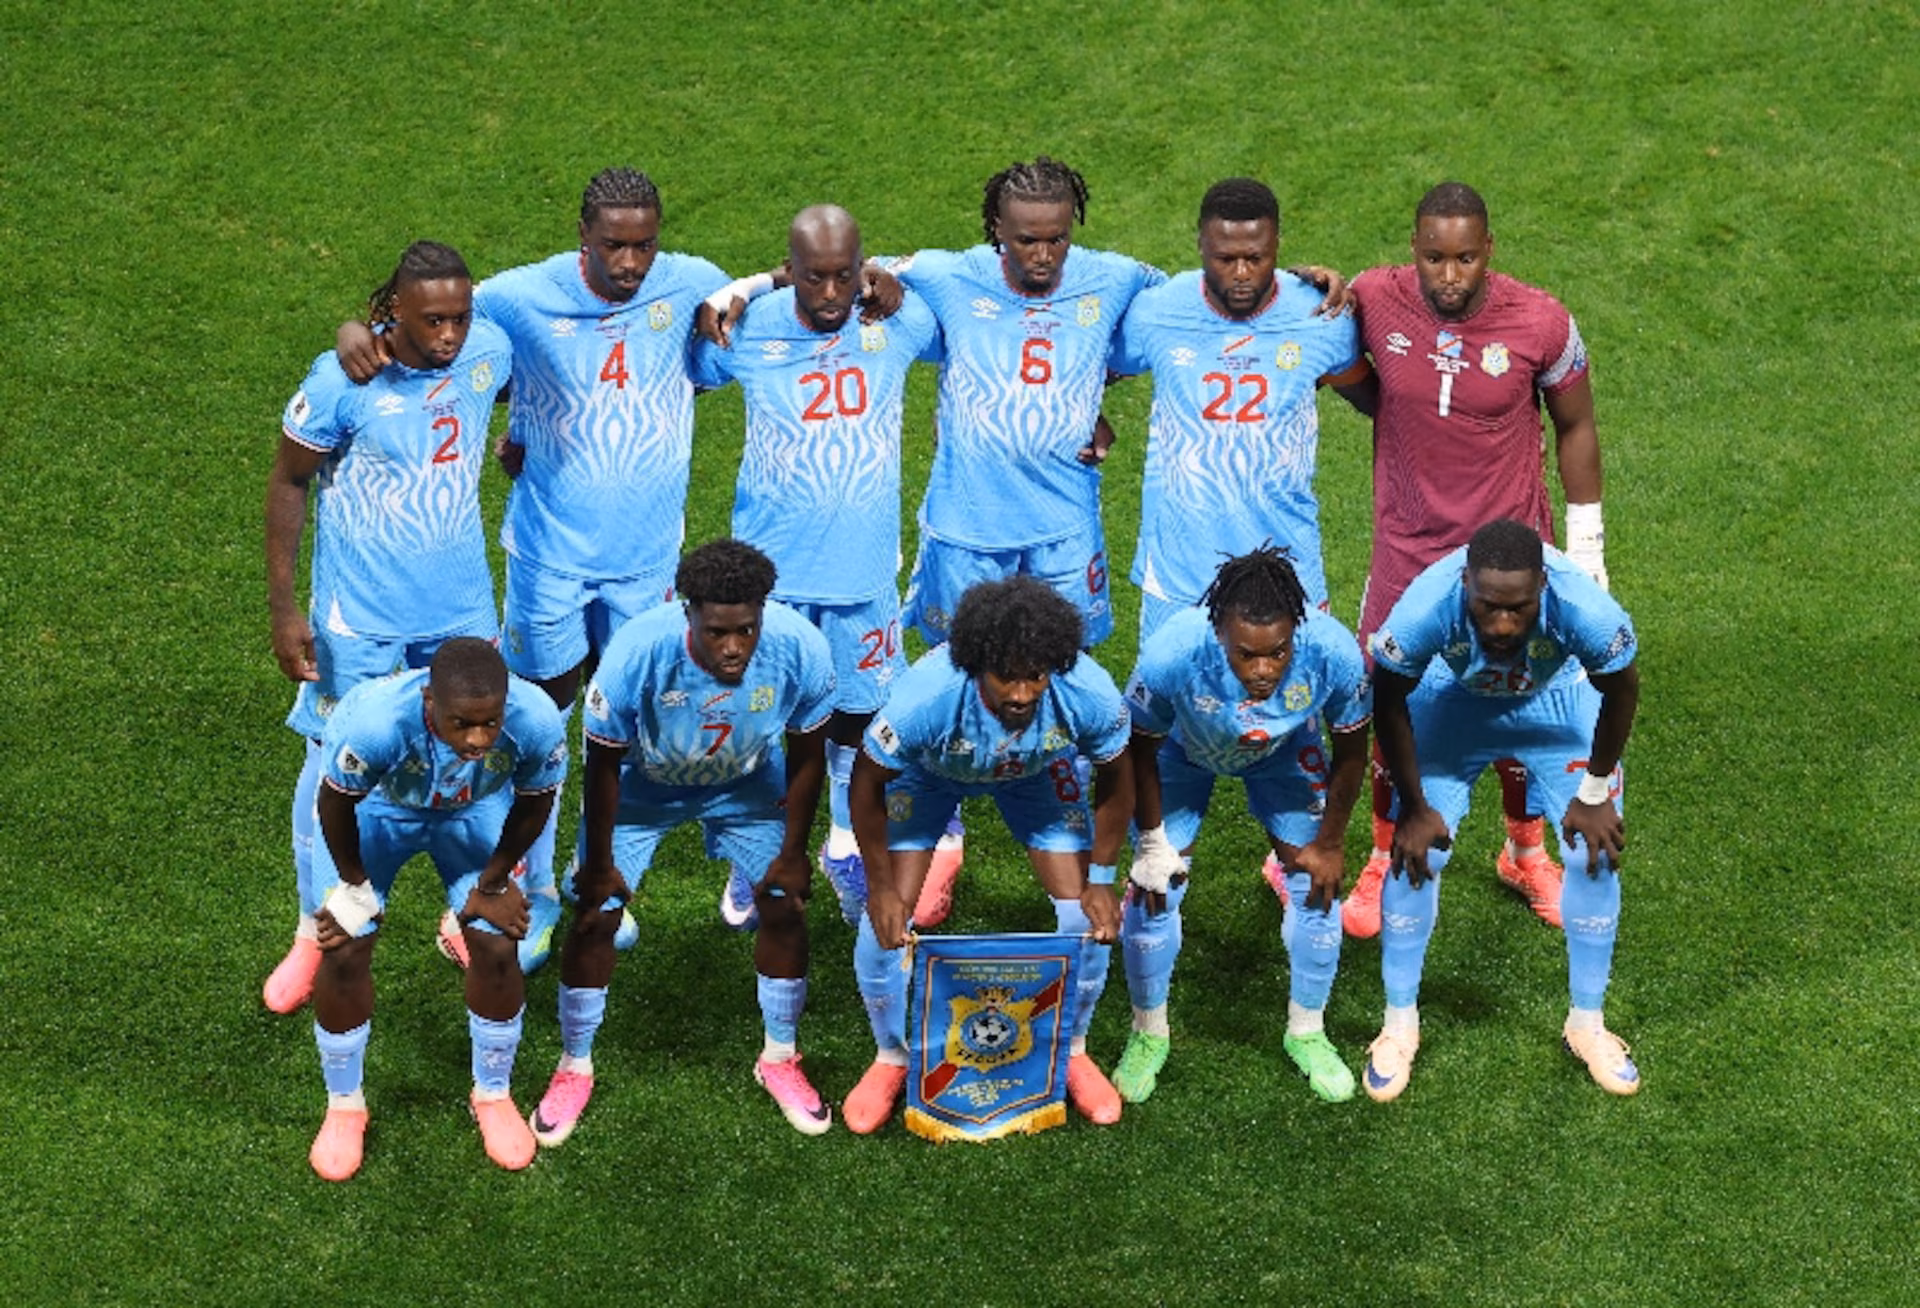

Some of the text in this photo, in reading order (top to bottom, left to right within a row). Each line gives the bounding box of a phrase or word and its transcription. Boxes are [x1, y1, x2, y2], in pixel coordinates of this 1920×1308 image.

[599, 341, 630, 390] 4
[1020, 338, 1053, 384] 6
[799, 367, 868, 422] 20
[1202, 371, 1268, 424] 22
[1438, 373, 1454, 418] 1
[431, 417, 461, 464] 2
[1087, 552, 1106, 595] 6
[702, 723, 733, 755] 7
[1051, 759, 1080, 802] 8
